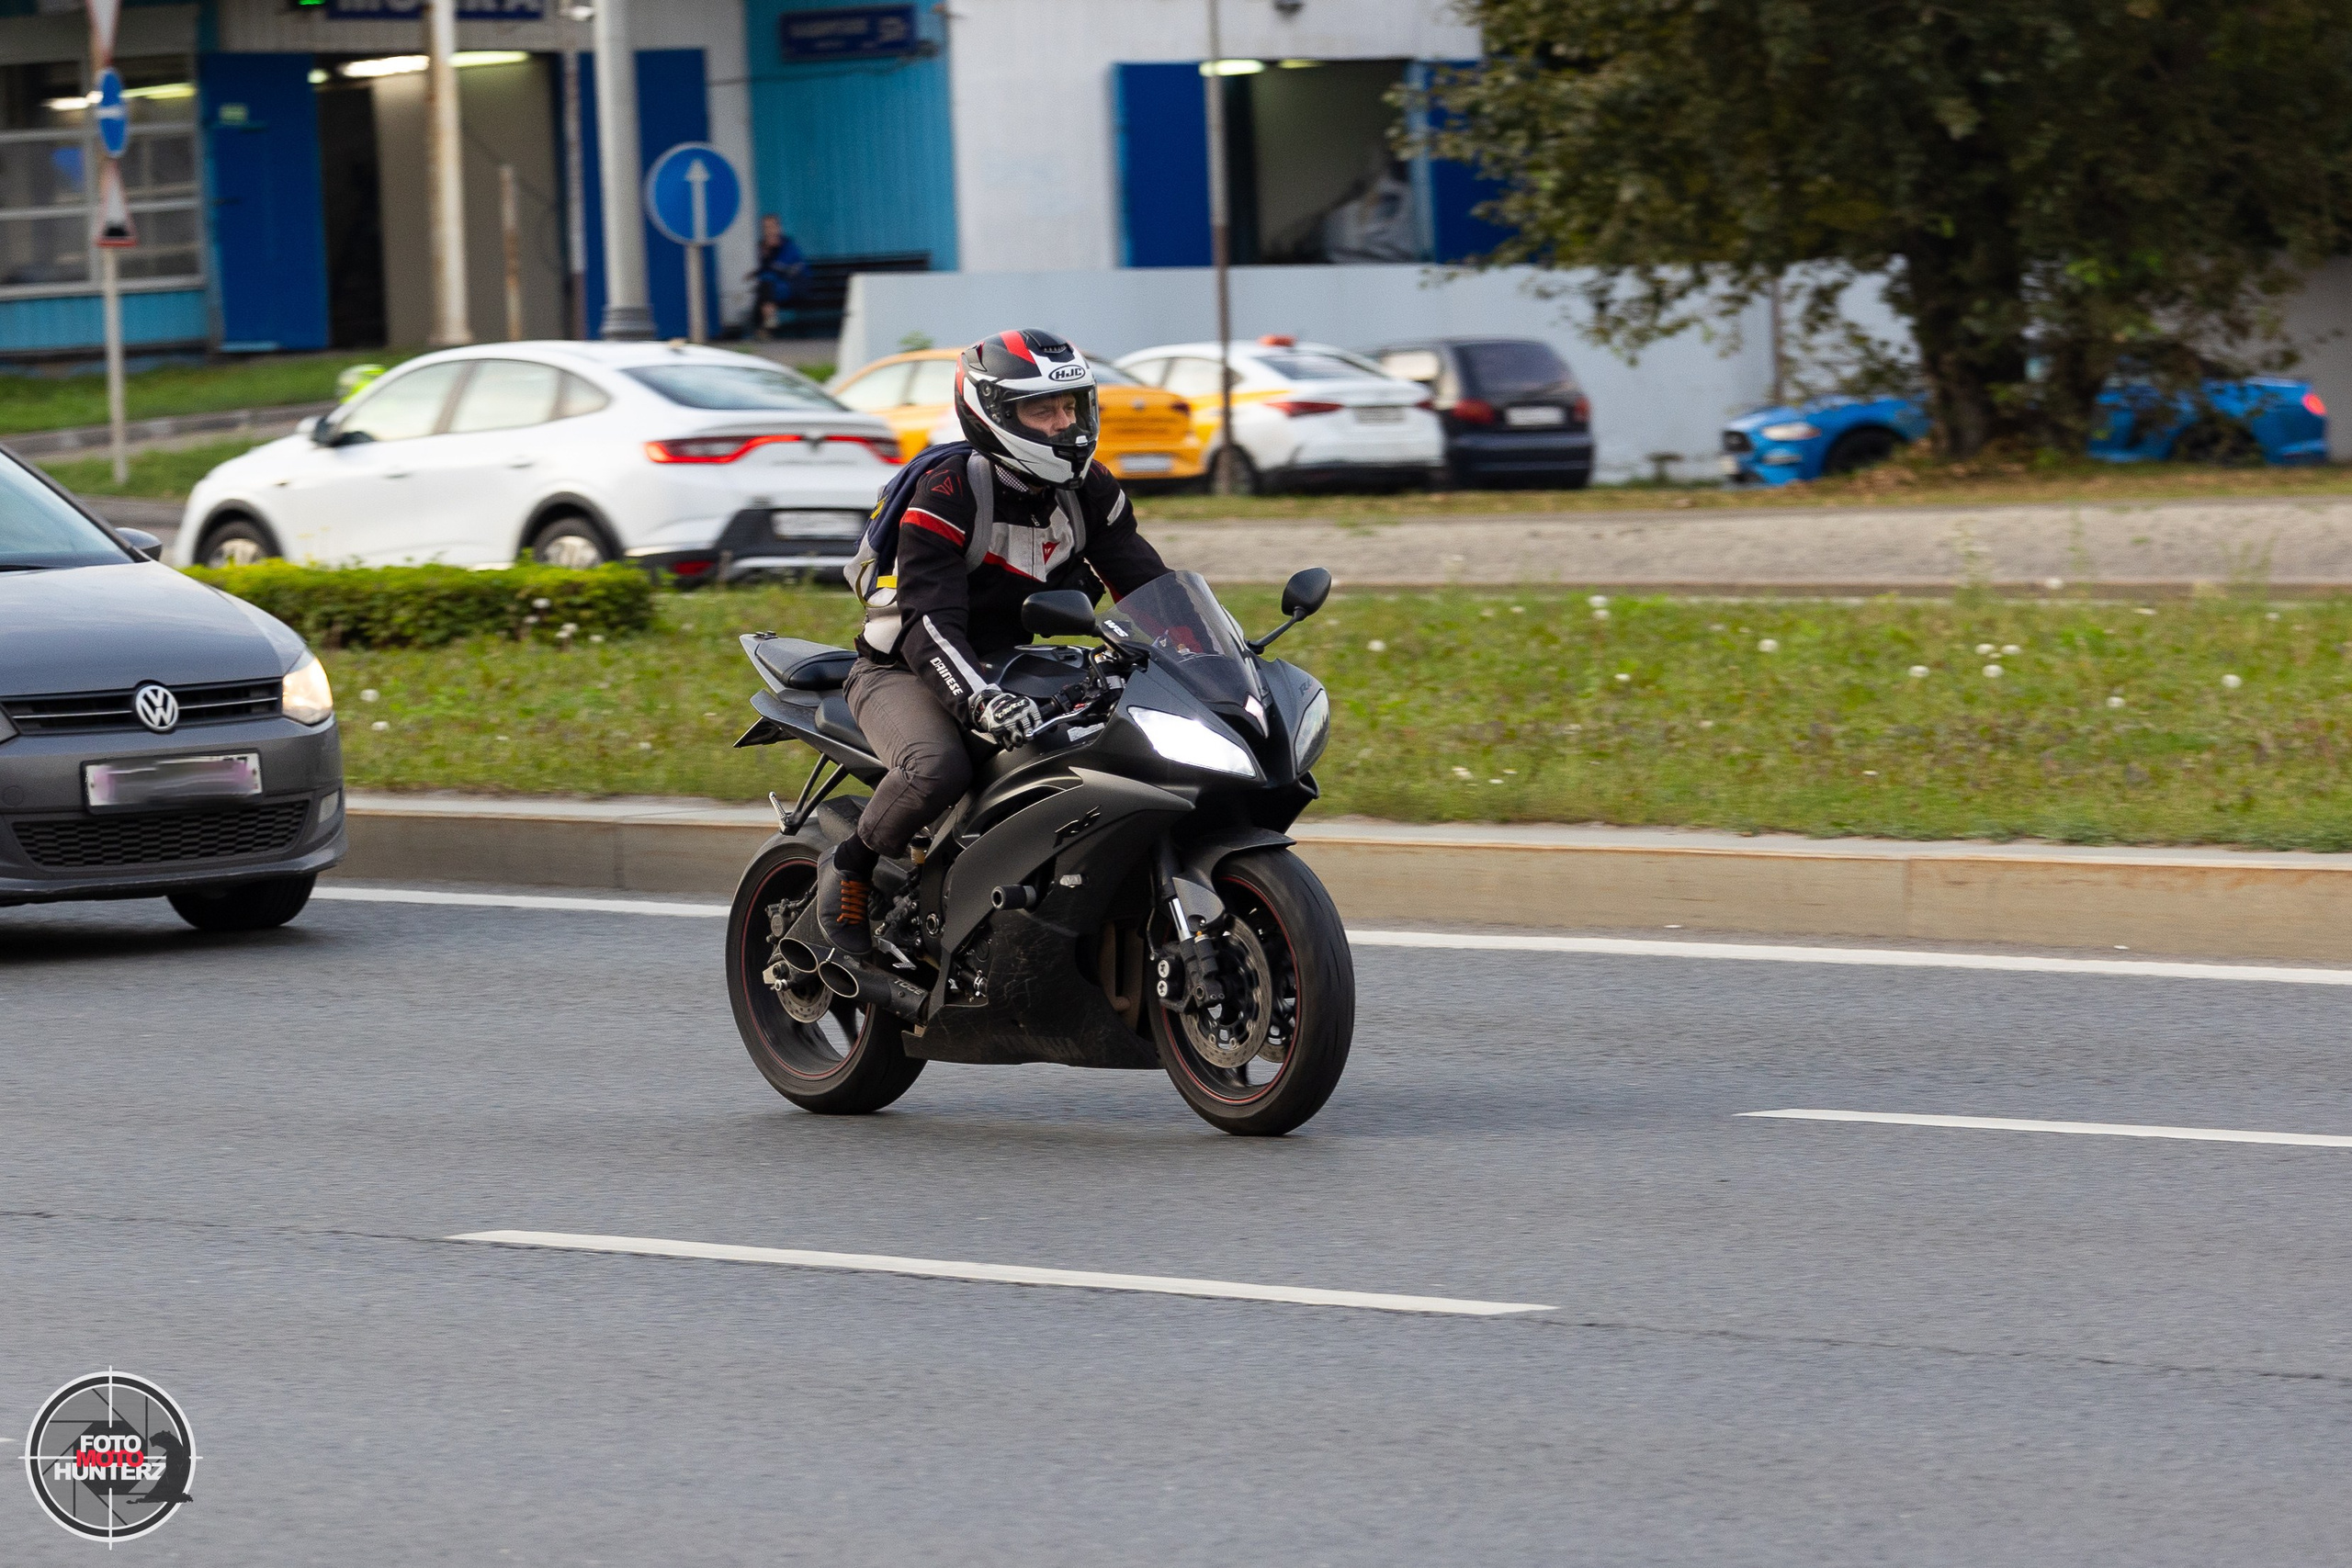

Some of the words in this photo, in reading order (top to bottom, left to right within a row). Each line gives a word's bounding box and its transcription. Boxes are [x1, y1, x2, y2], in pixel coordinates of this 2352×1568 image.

[1055, 367, 1082, 379] HJC
[930, 657, 964, 696] DAINESE
[1053, 805, 1102, 848] R6
